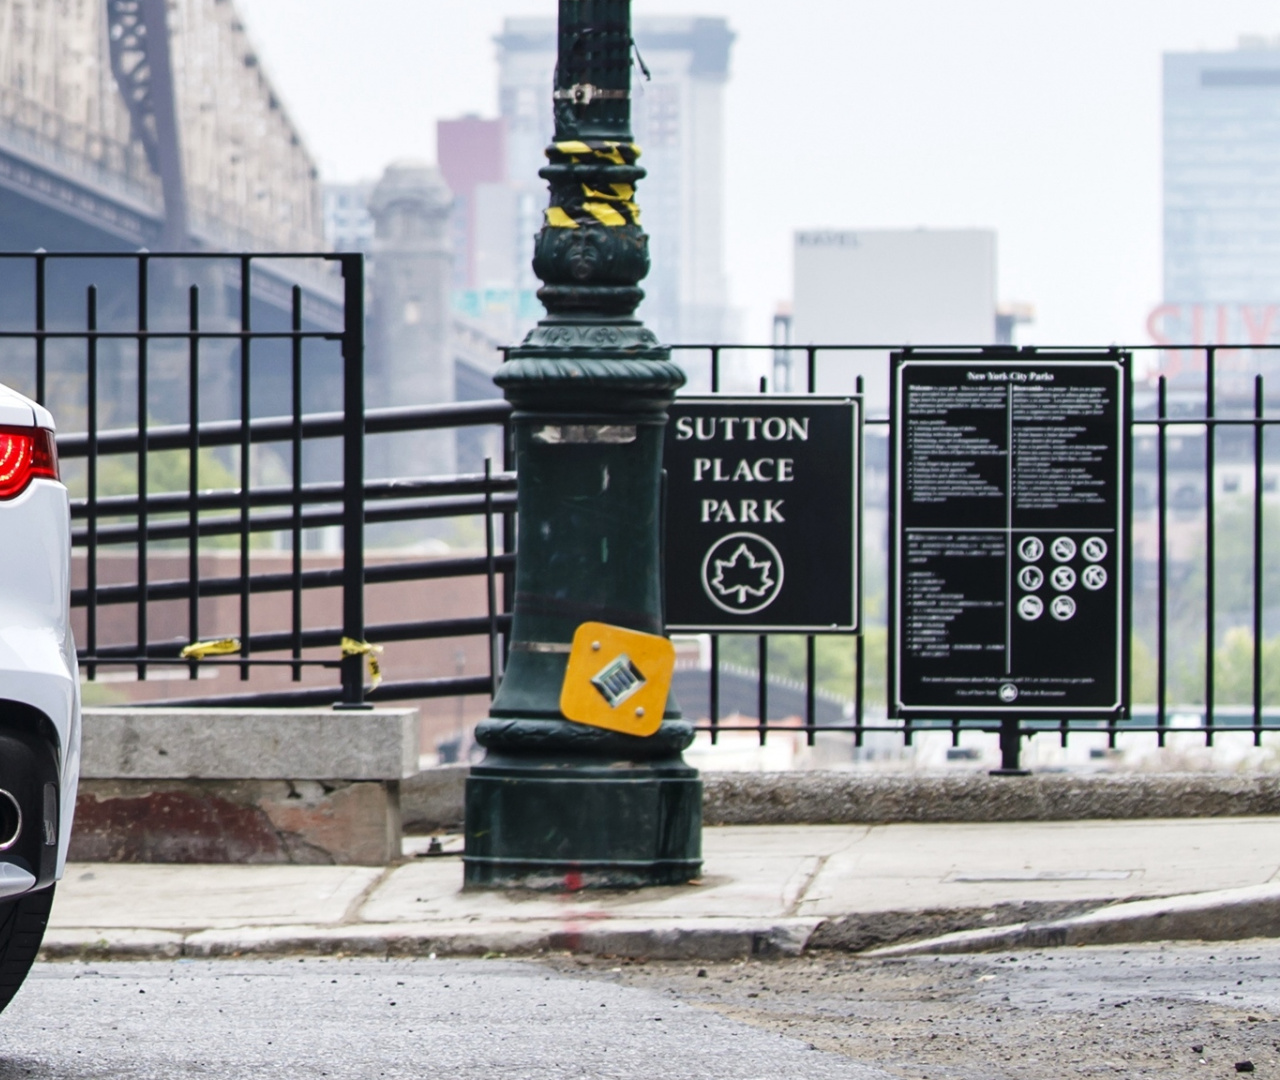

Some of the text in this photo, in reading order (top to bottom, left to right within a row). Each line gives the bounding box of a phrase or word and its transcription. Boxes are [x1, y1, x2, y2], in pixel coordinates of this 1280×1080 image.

[967, 371, 1055, 383] New York City Parks
[675, 416, 810, 442] SUTTON
[693, 457, 795, 482] PLACE
[700, 498, 786, 523] PARK
